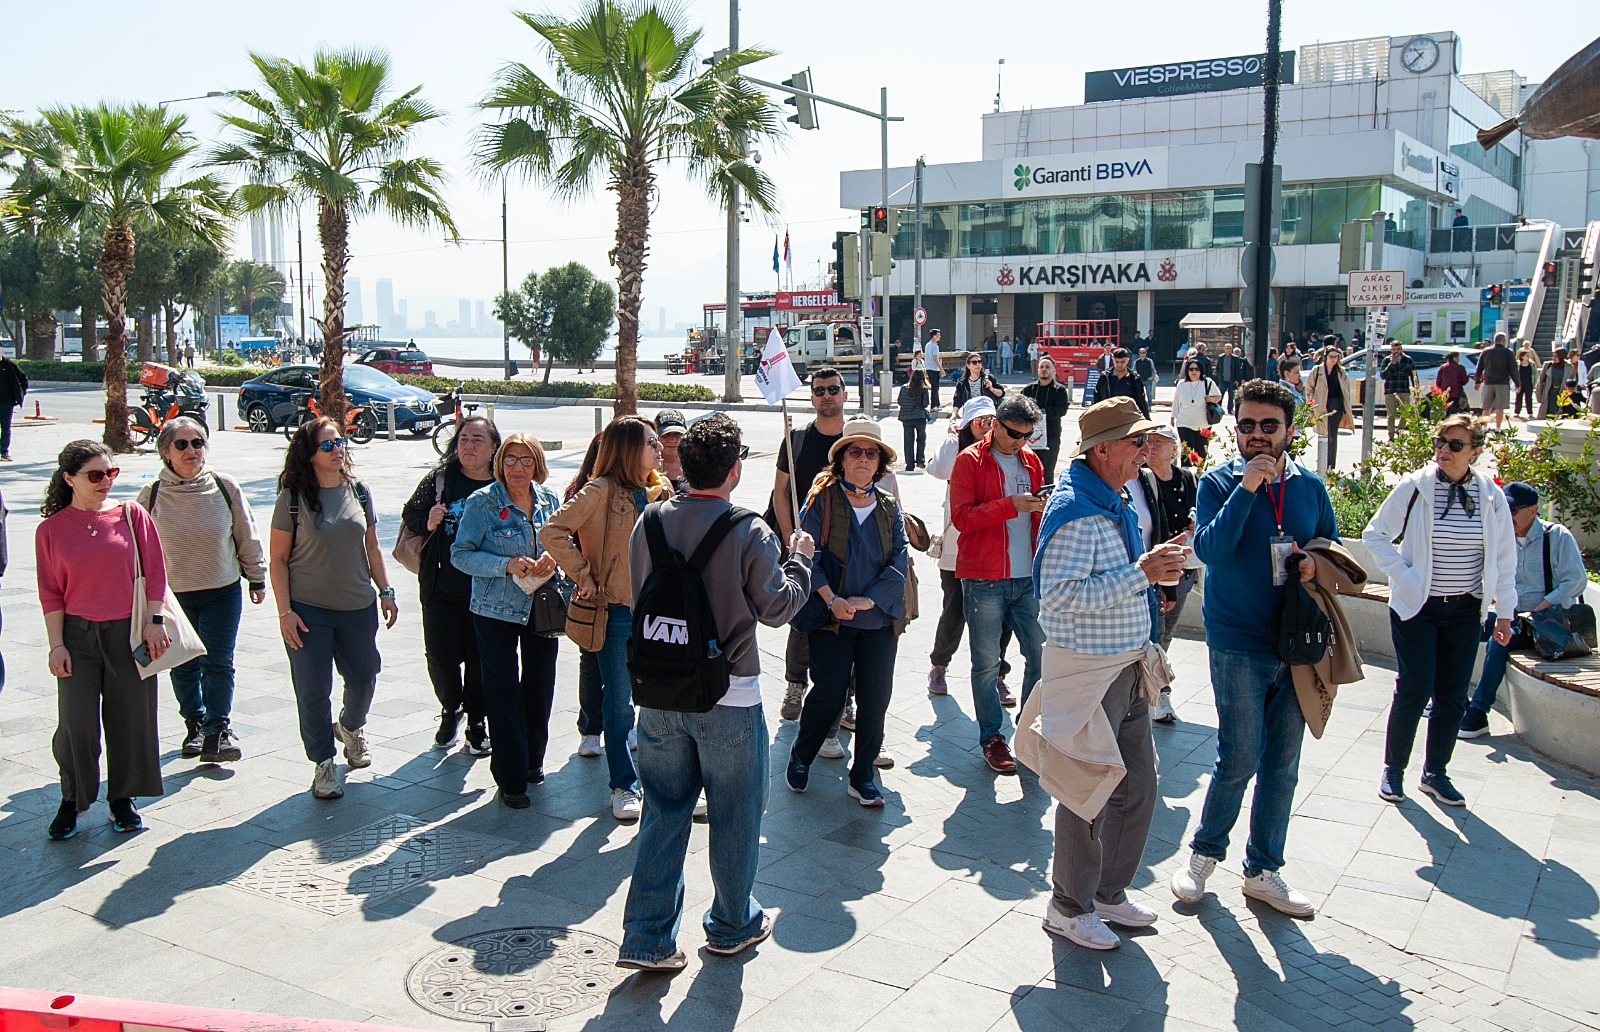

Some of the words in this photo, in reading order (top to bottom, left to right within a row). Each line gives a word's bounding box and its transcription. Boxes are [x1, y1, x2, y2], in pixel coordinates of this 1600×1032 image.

[1032, 165, 1092, 184] Garanti
[1096, 158, 1153, 180] BBVA
[1019, 263, 1151, 288] KARŞIYAKA
[792, 294, 827, 307] HERGELE
[827, 291, 848, 306] BÜ
[1351, 294, 1402, 302] YASAIR
[1411, 292, 1438, 300] Garanti
[1438, 292, 1464, 300] BBVA
